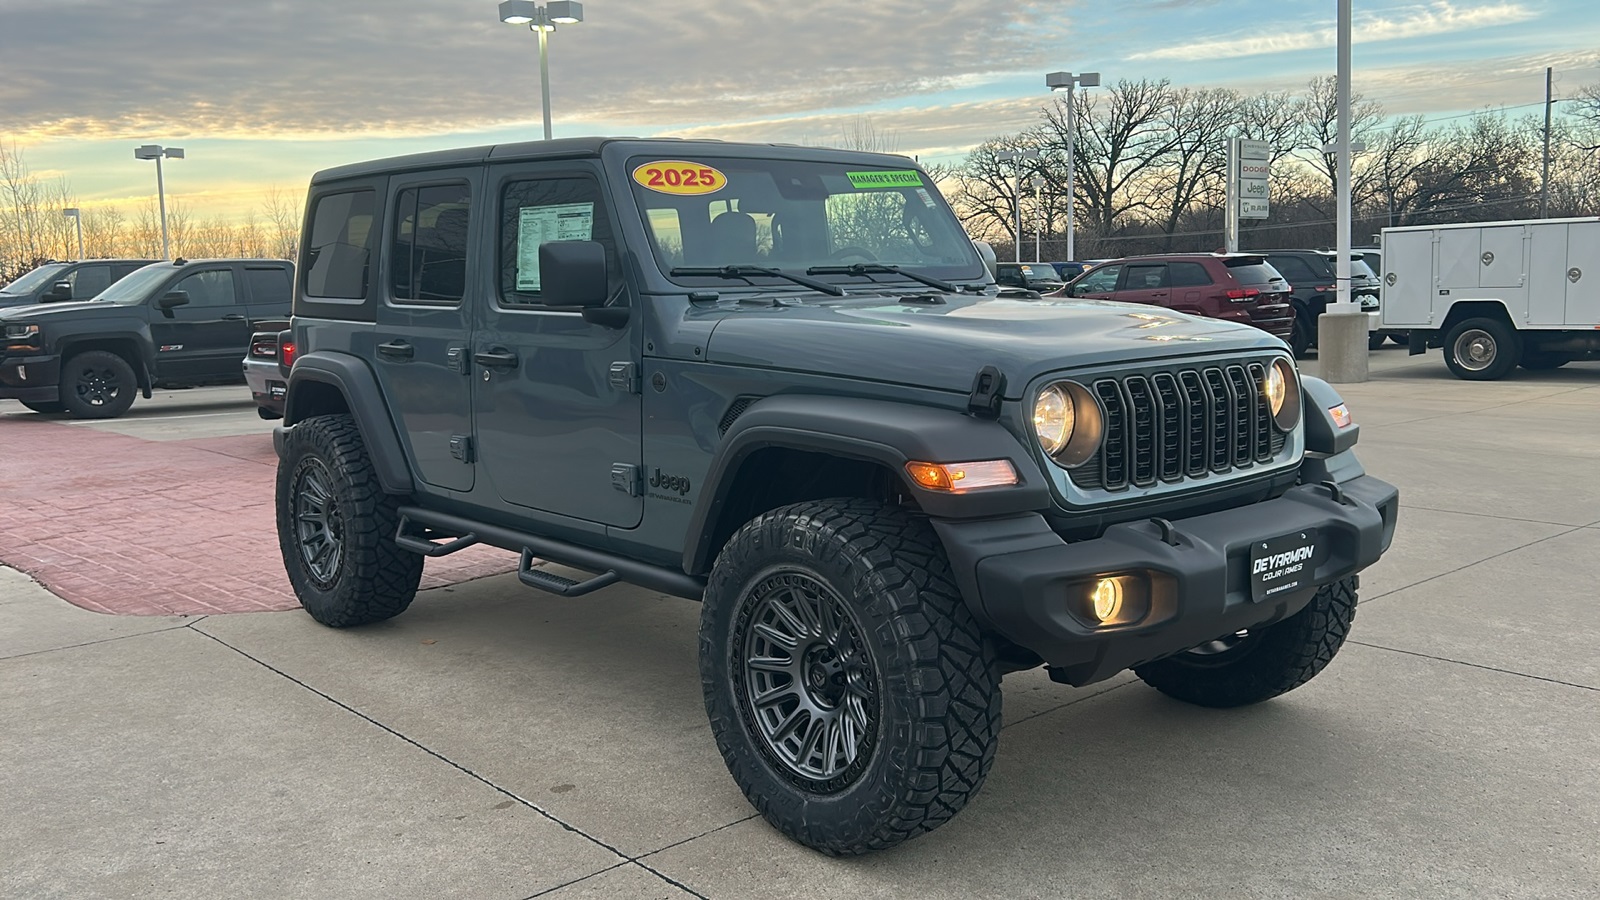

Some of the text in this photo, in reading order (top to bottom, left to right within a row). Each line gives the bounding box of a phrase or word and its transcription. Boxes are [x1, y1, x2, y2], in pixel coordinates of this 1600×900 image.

[646, 168, 716, 188] 2025
[850, 173, 921, 185] MANAGER'S SPECIAL
[1247, 182, 1265, 195] Jeep
[649, 467, 691, 496] Jeep
[1253, 545, 1315, 575] DEYARMAN
[1284, 562, 1304, 576] AMES
